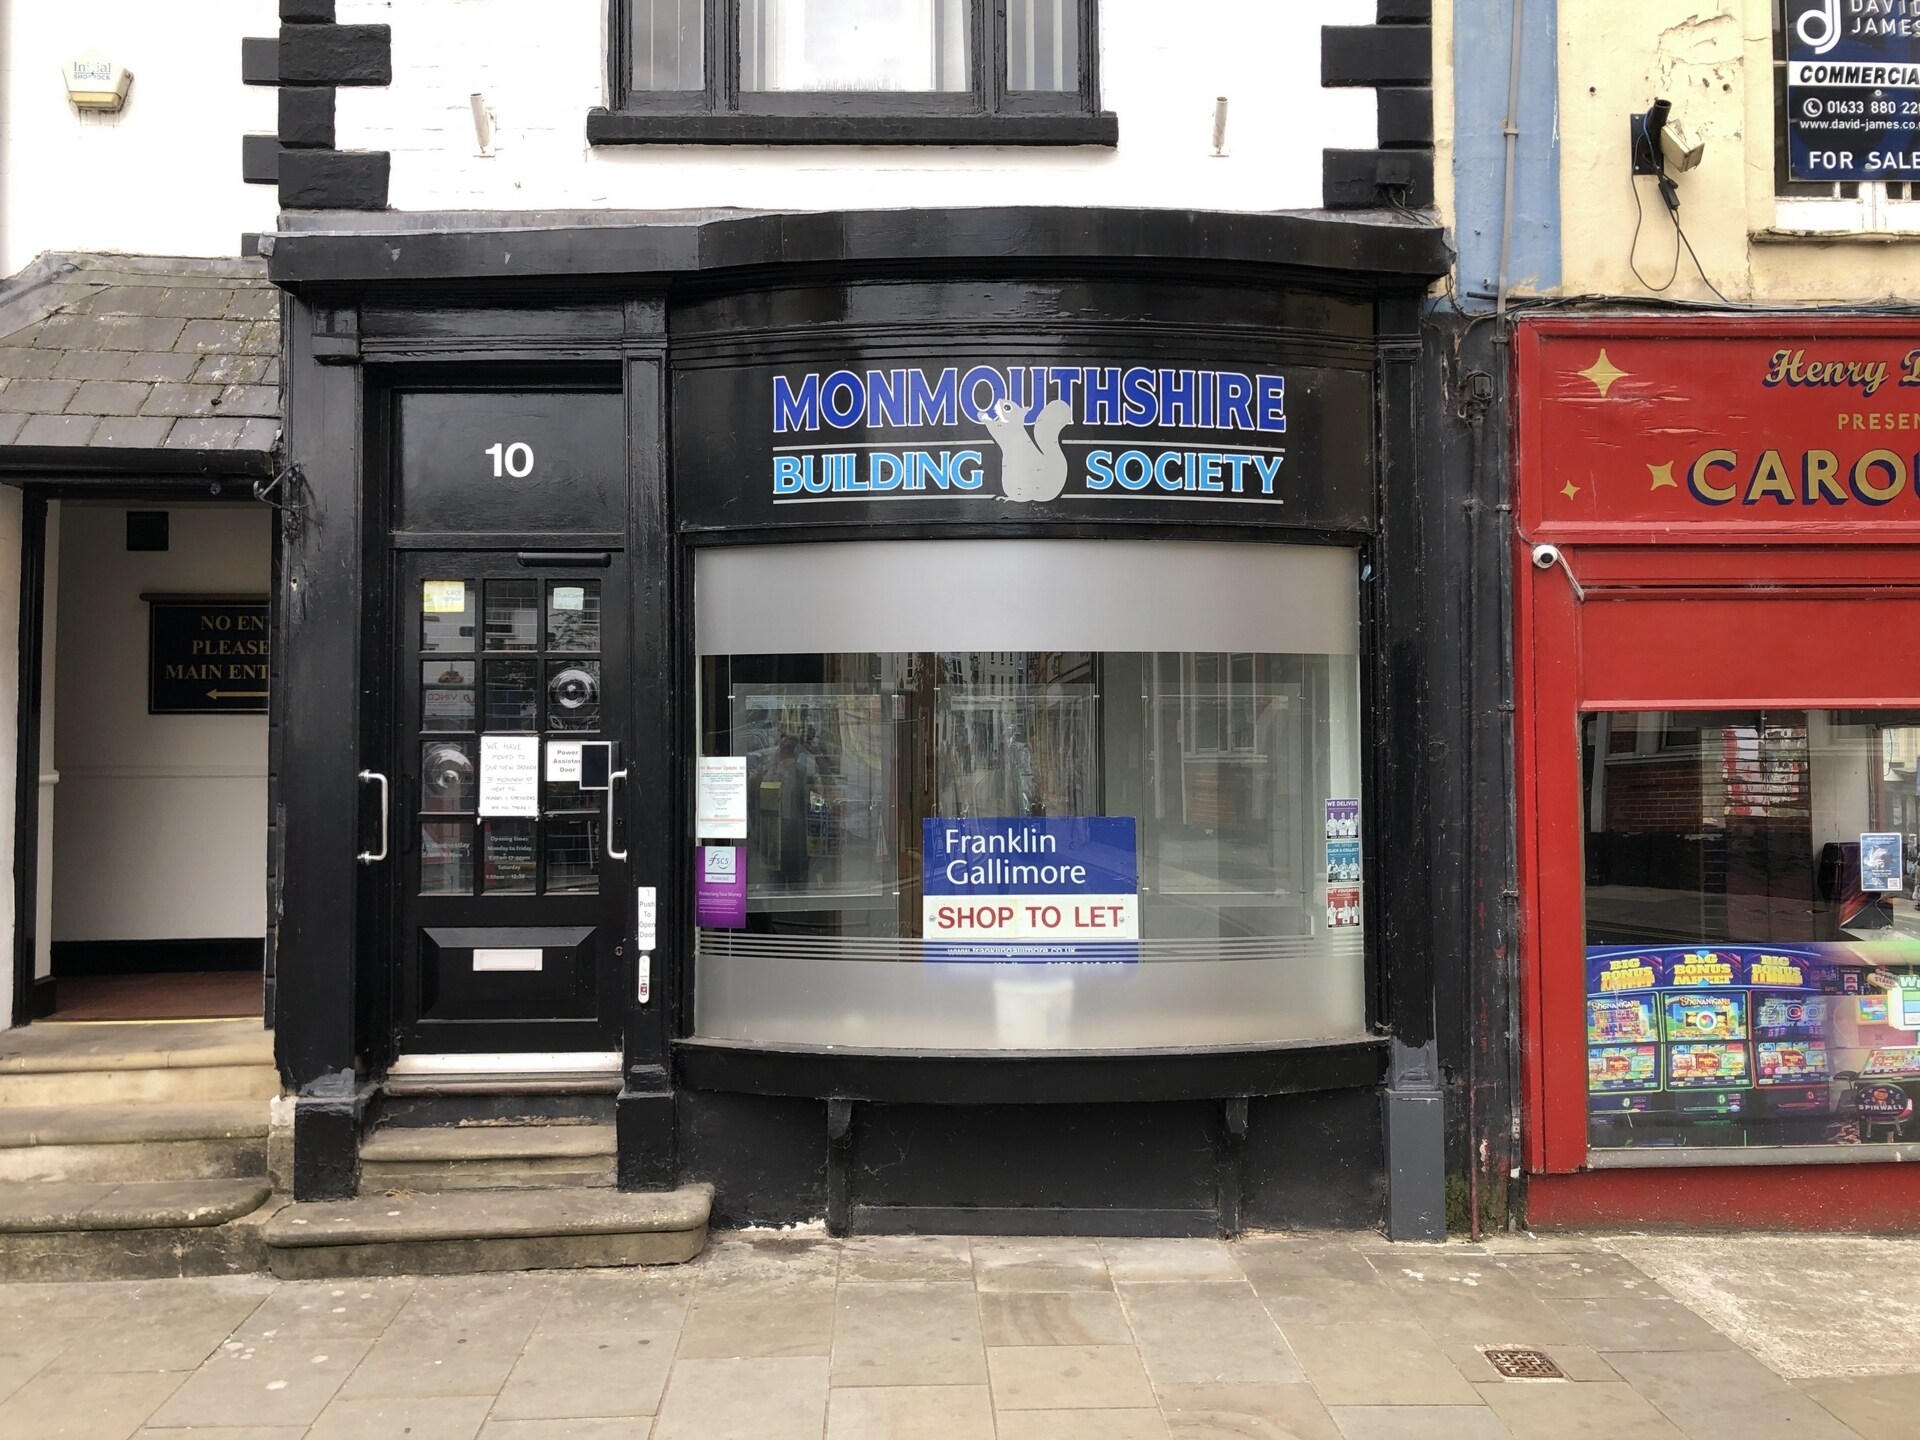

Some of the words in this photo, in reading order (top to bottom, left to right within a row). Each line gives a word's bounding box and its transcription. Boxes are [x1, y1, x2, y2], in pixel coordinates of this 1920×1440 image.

[1827, 101, 1864, 114] 01633
[1871, 101, 1896, 114] 880
[1902, 102, 1920, 114] 22
[1800, 119, 1920, 131] www.david-james.co.
[1809, 151, 1853, 169] FOR
[1868, 151, 1920, 169] SALE
[1762, 349, 1889, 397] Henry
[773, 365, 1287, 433] MONMOUTHSHIRE
[485, 442, 534, 478] 10
[773, 450, 984, 495] BUILDING
[1085, 450, 1284, 494] SOCIETY
[1687, 449, 1920, 507] CARO
[200, 615, 231, 631] NO
[192, 640, 270, 655] PLEASE
[165, 664, 222, 680] MAIN
[946, 827, 1056, 854] Franklin
[946, 858, 1086, 885] Gallimore
[639, 921, 656, 929] Open
[937, 906, 1014, 929] SHOP
[1025, 905, 1061, 928] TO
[1074, 905, 1124, 928] LET
[640, 931, 655, 939] Door
[1610, 958, 1640, 970] BIG
[1761, 955, 1790, 966] BIG
[1601, 966, 1653, 980] BONUS
[1674, 963, 1731, 975] BONUS
[1751, 963, 1801, 976] BONUS
